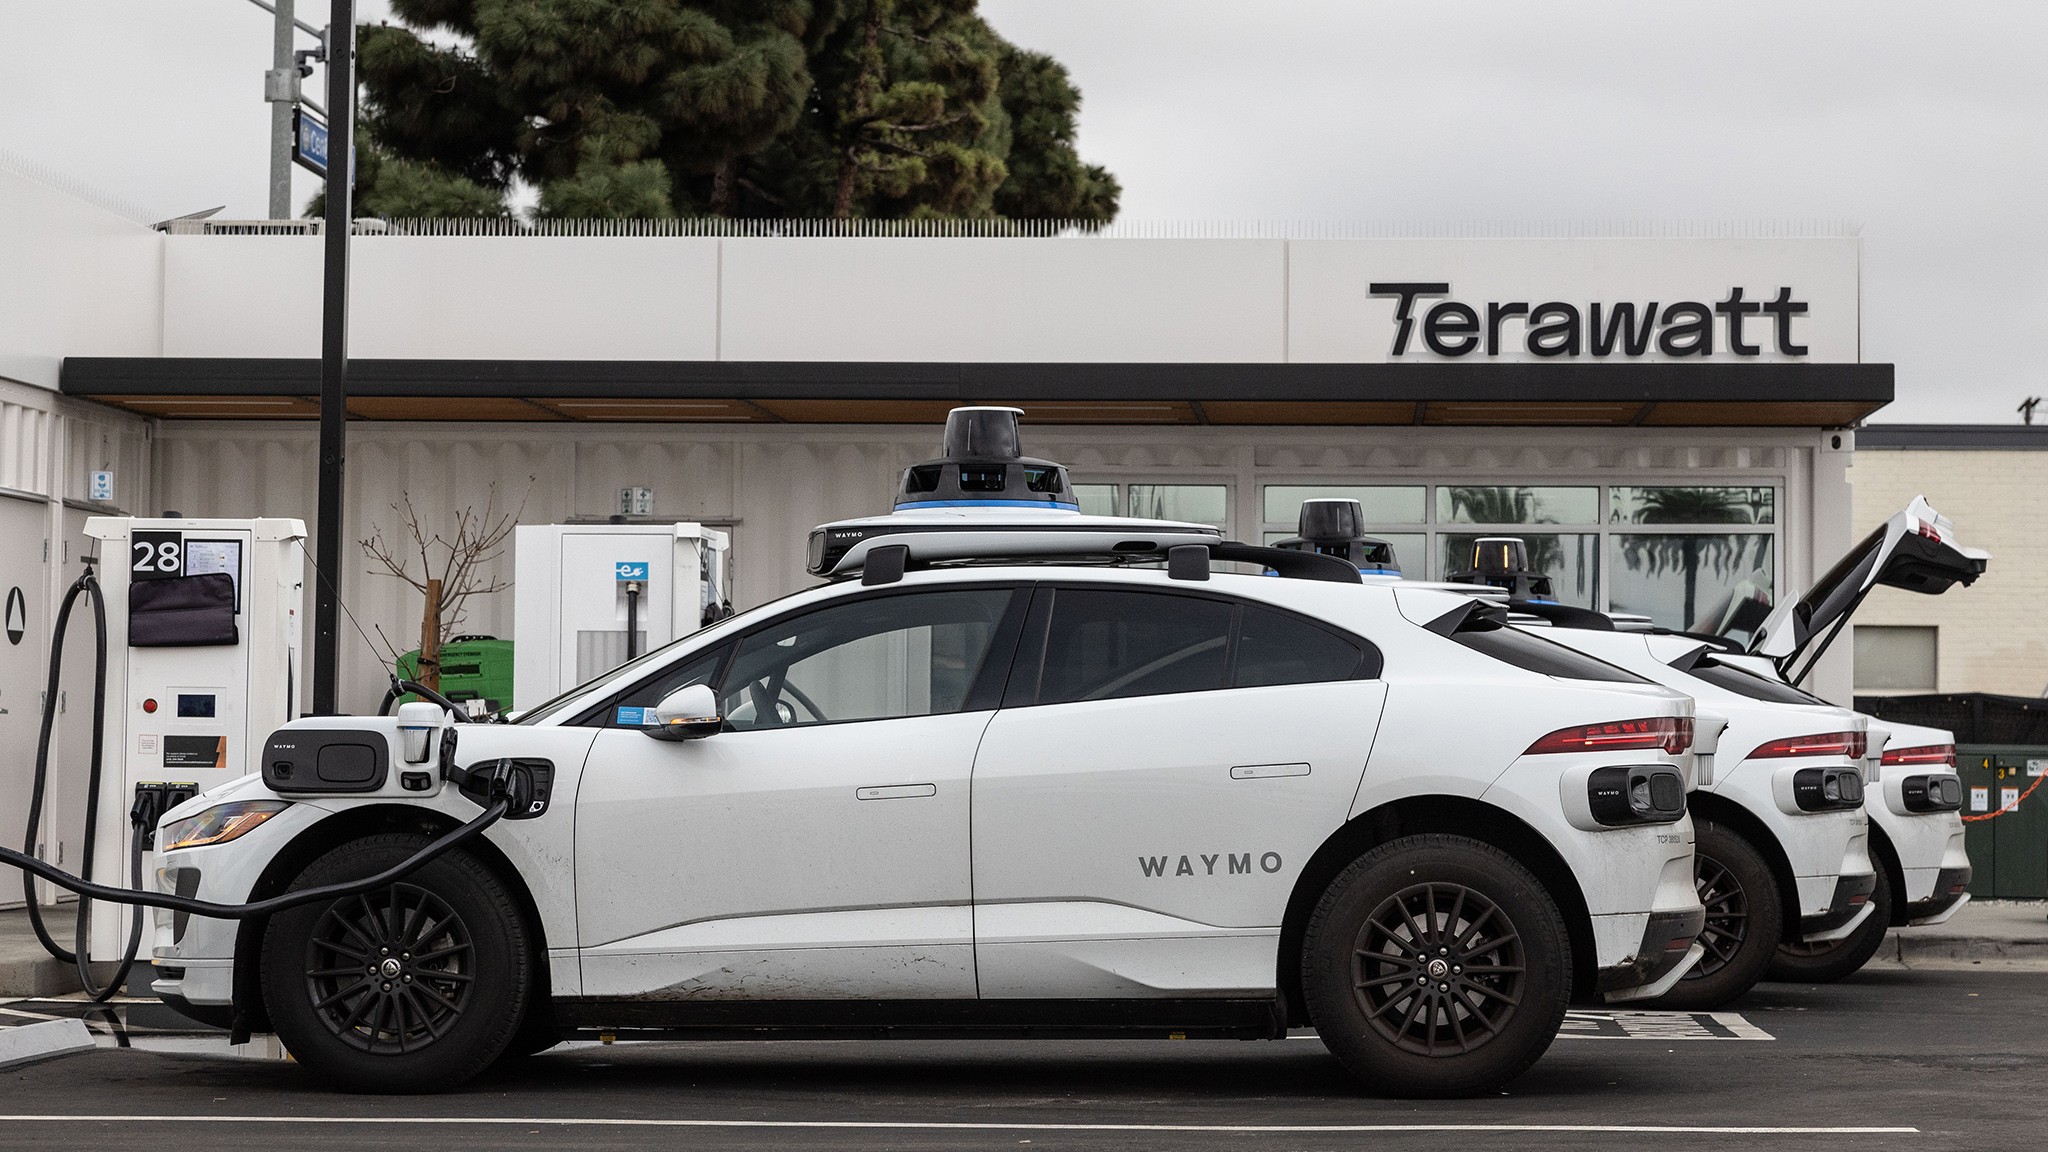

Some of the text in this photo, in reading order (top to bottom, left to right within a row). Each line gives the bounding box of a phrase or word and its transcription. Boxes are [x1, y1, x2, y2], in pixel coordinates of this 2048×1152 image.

[1369, 282, 1808, 356] Terawatt
[133, 541, 180, 572] 28
[1983, 758, 1989, 769] 4
[1998, 768, 2005, 780] 3
[1138, 851, 1283, 878] WAYMO
